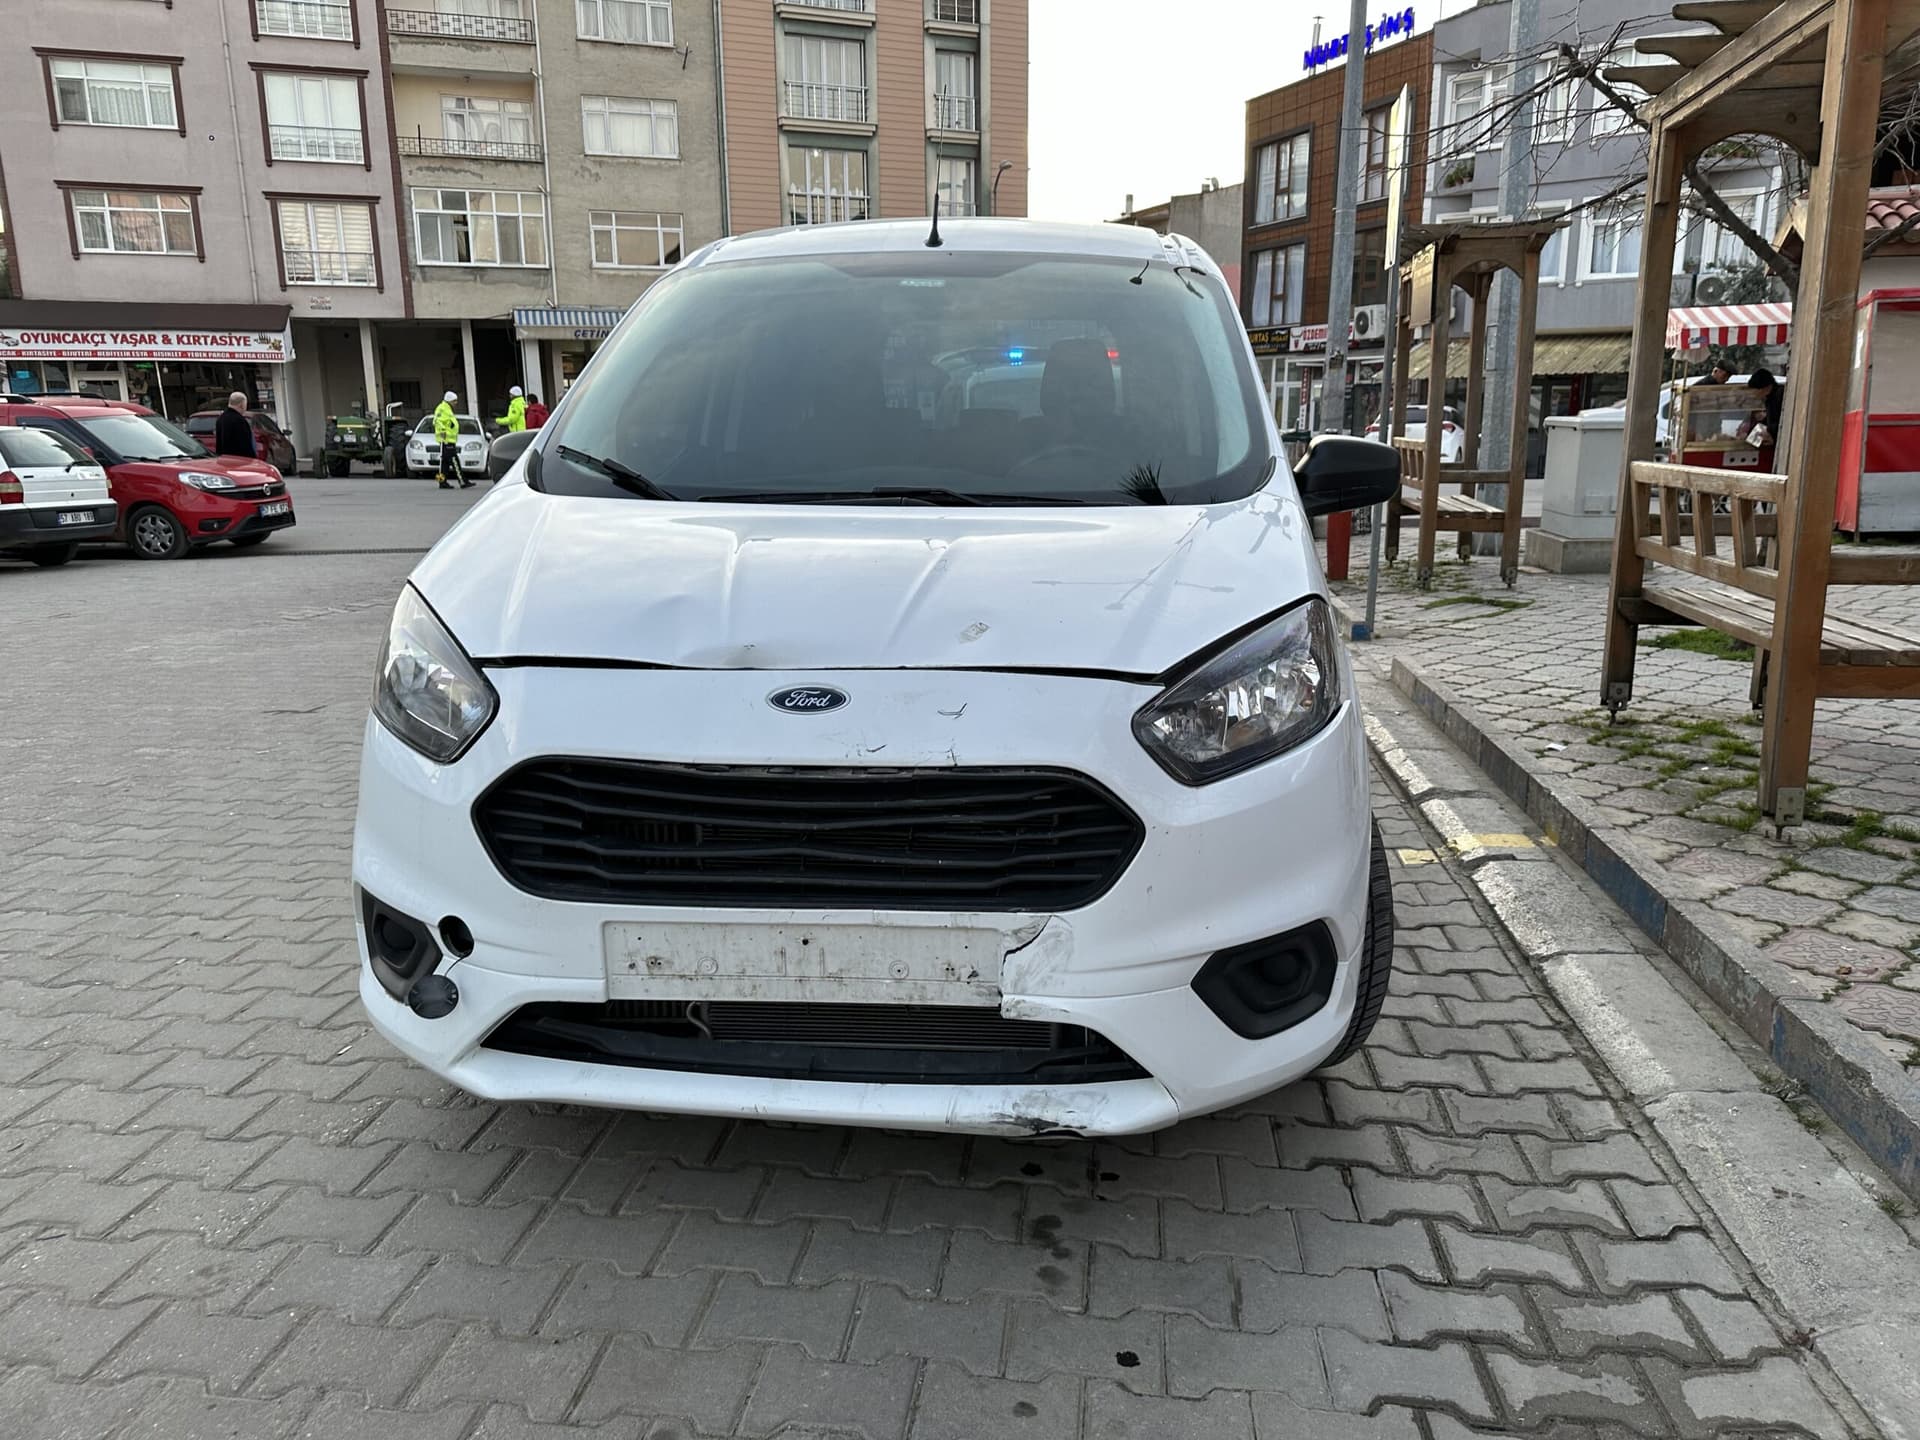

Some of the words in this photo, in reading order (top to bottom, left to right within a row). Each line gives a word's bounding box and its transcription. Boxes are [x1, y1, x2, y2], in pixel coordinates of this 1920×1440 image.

[20, 332, 107, 347] OYUNCAKÇI
[110, 332, 158, 347] YAŞAR
[161, 333, 172, 346] &
[176, 331, 252, 347] KIRTASİYE
[785, 690, 831, 706] Ford
